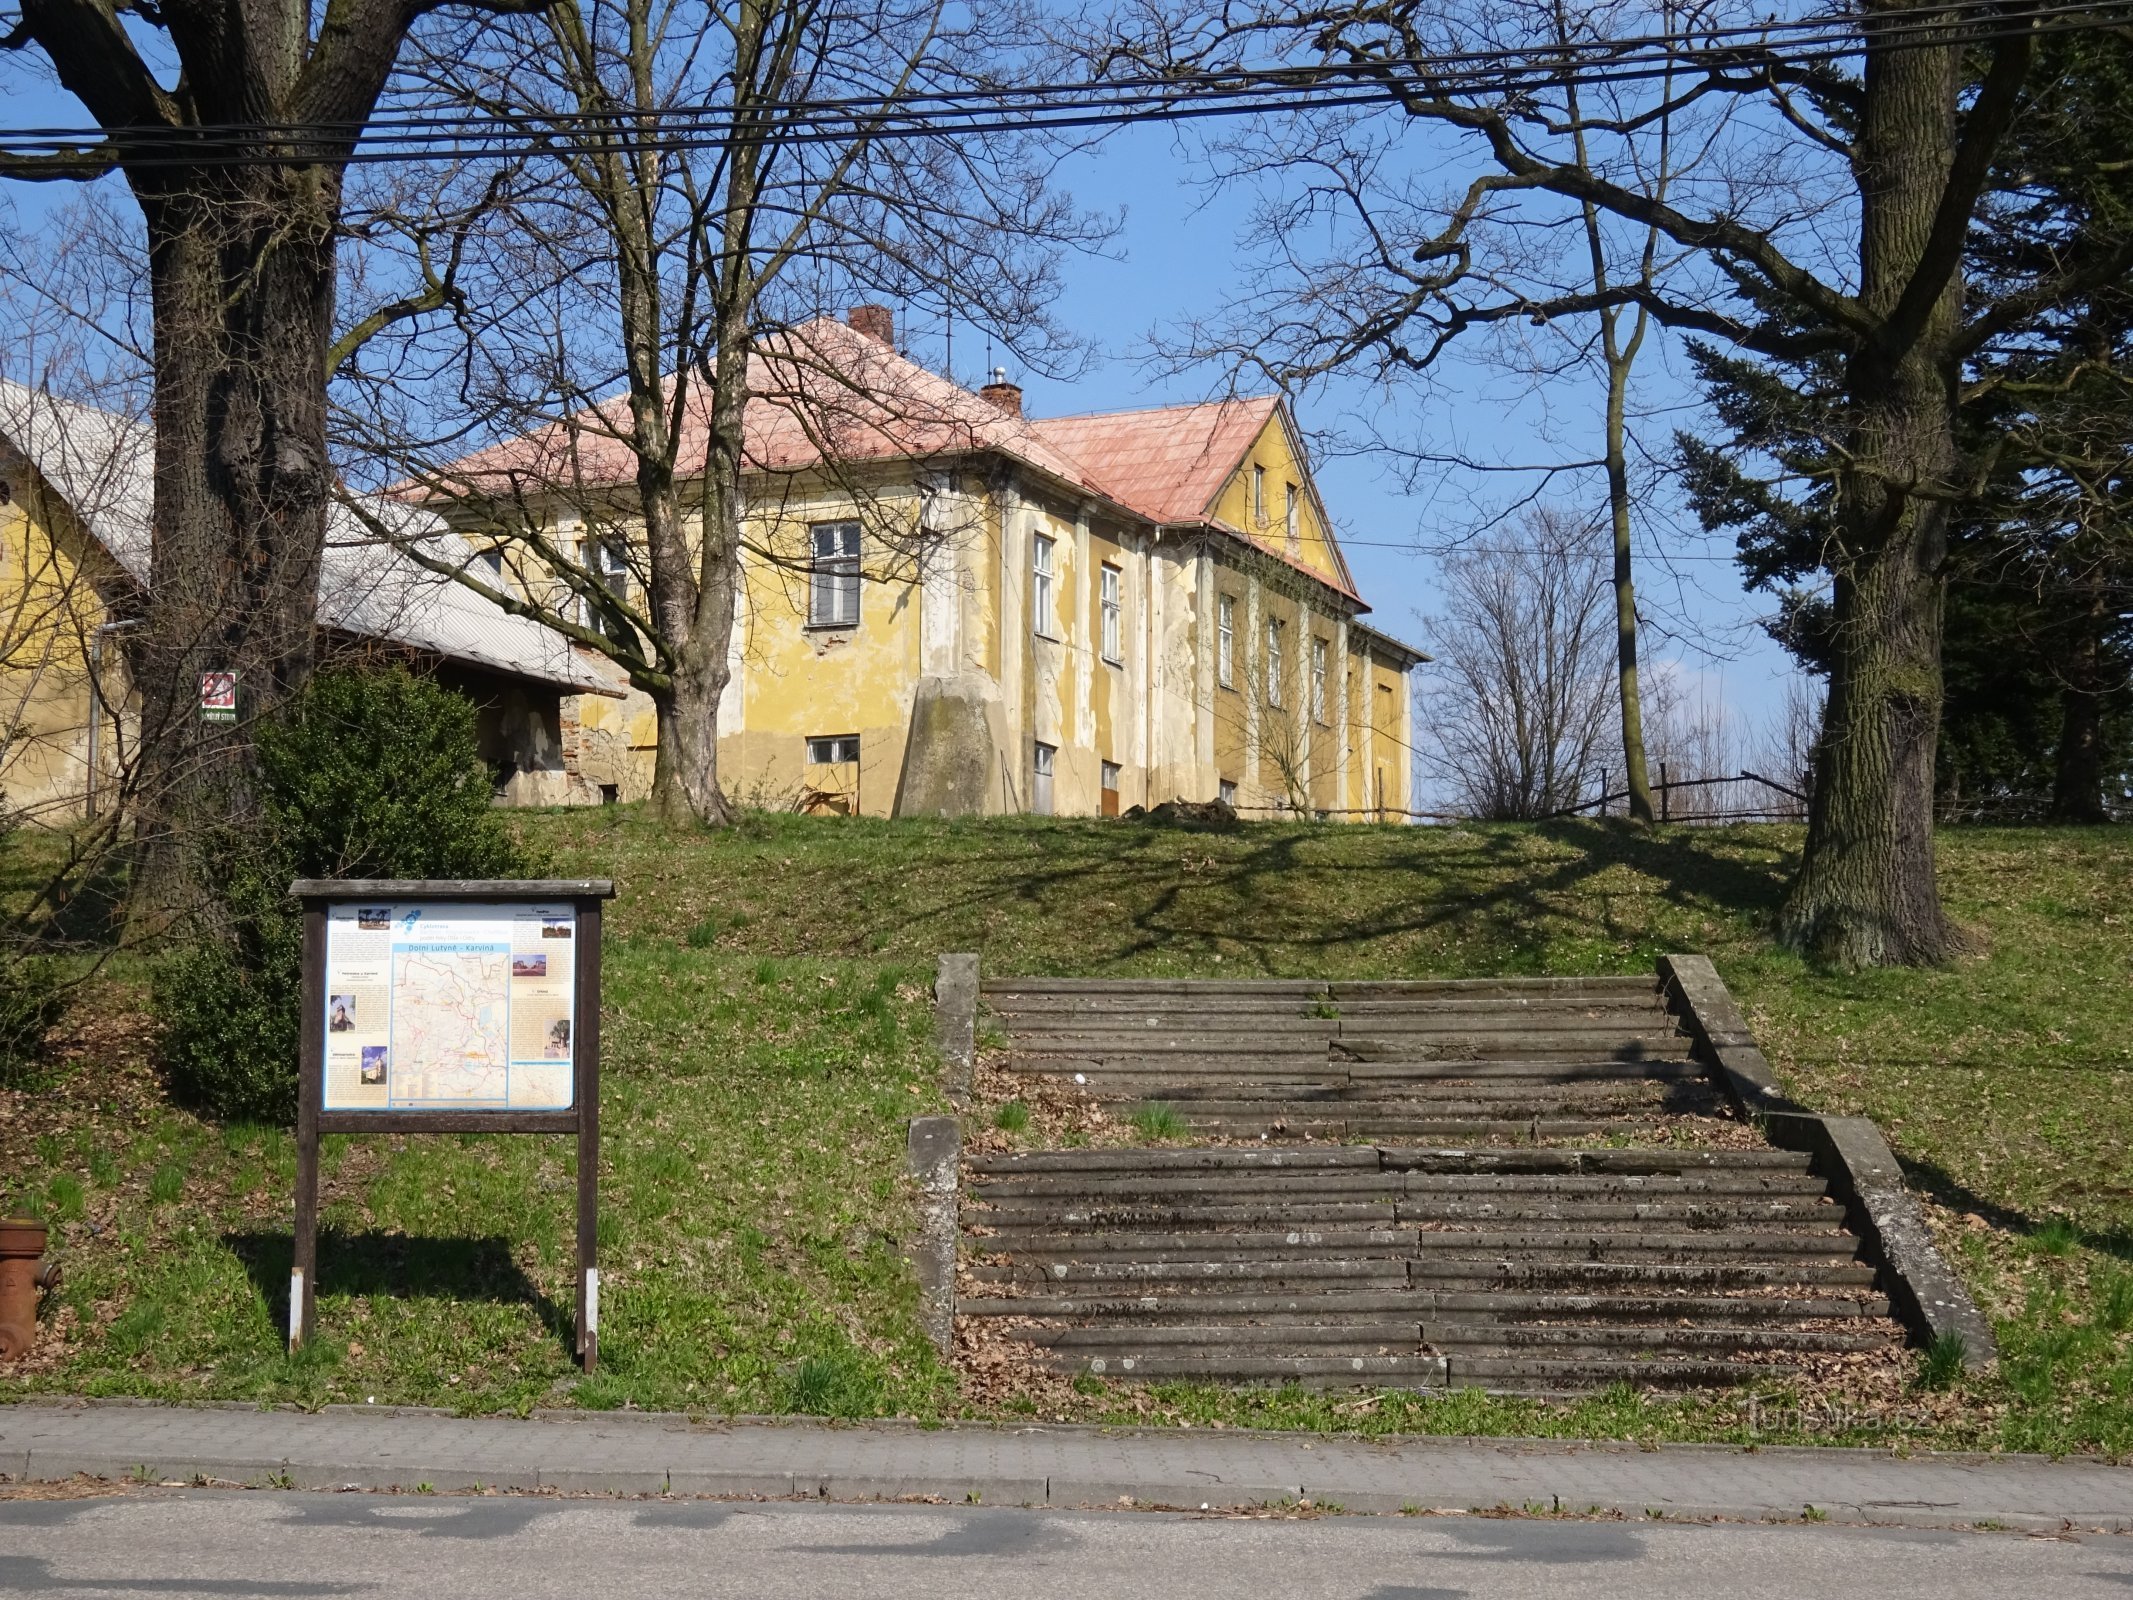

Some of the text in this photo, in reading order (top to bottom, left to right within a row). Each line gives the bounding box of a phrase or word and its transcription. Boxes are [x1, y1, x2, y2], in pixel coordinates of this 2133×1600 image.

[408, 944, 429, 952] Dolní
[431, 944, 457, 952] Lutyně
[466, 944, 494, 952] Karviná
